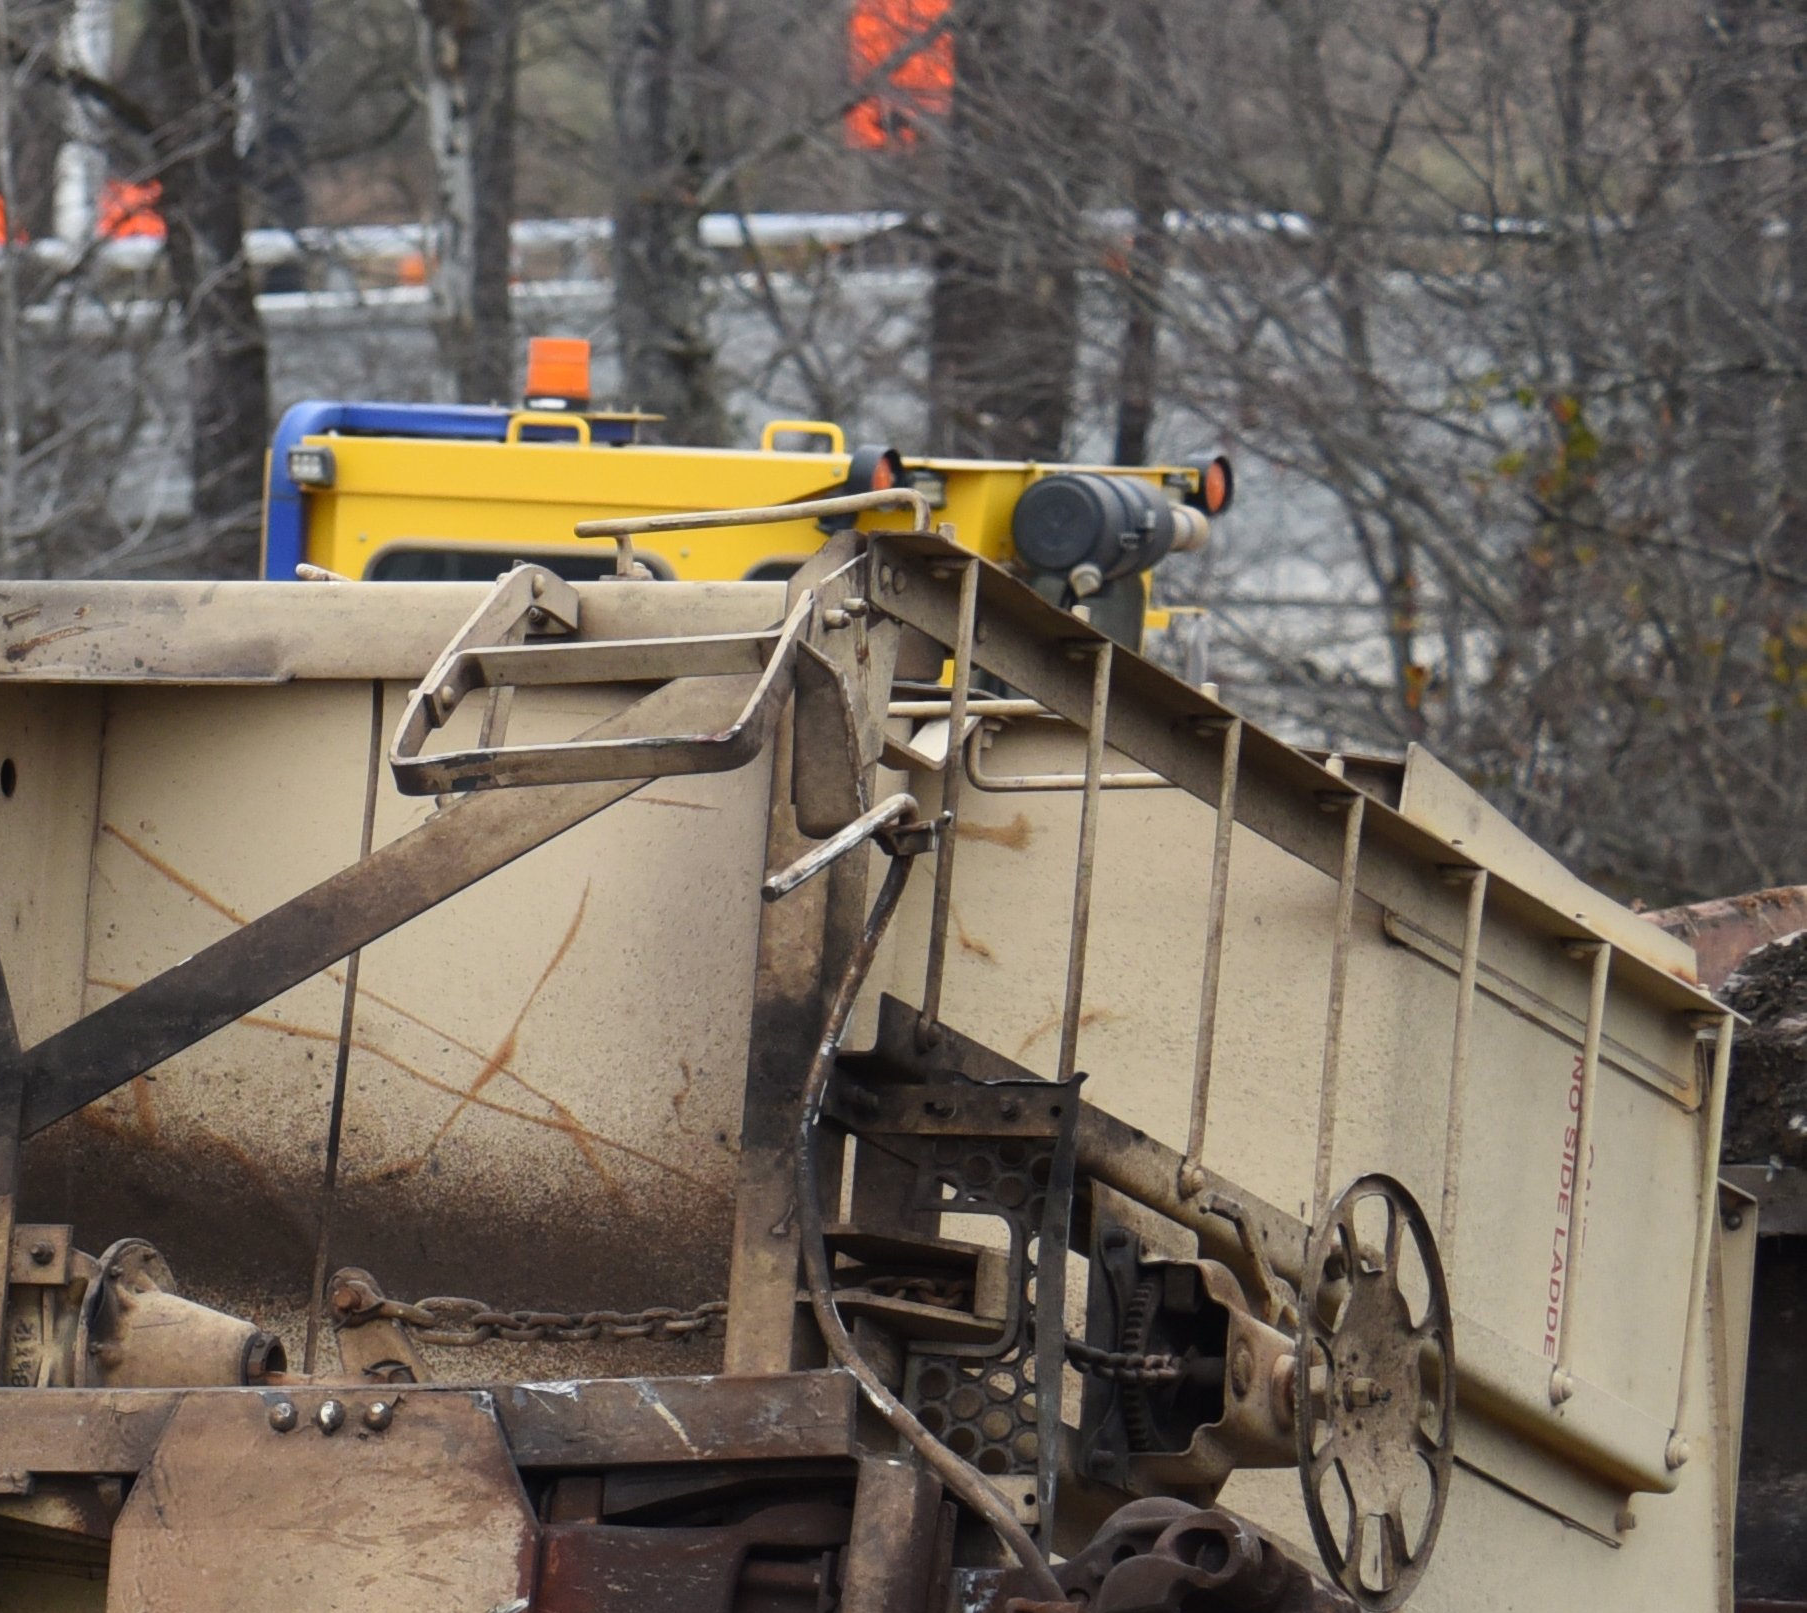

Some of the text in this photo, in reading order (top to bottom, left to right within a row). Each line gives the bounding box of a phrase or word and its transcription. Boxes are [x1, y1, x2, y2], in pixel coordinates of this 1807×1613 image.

[1543, 1054, 1585, 1360] NO SIDE LADDE
